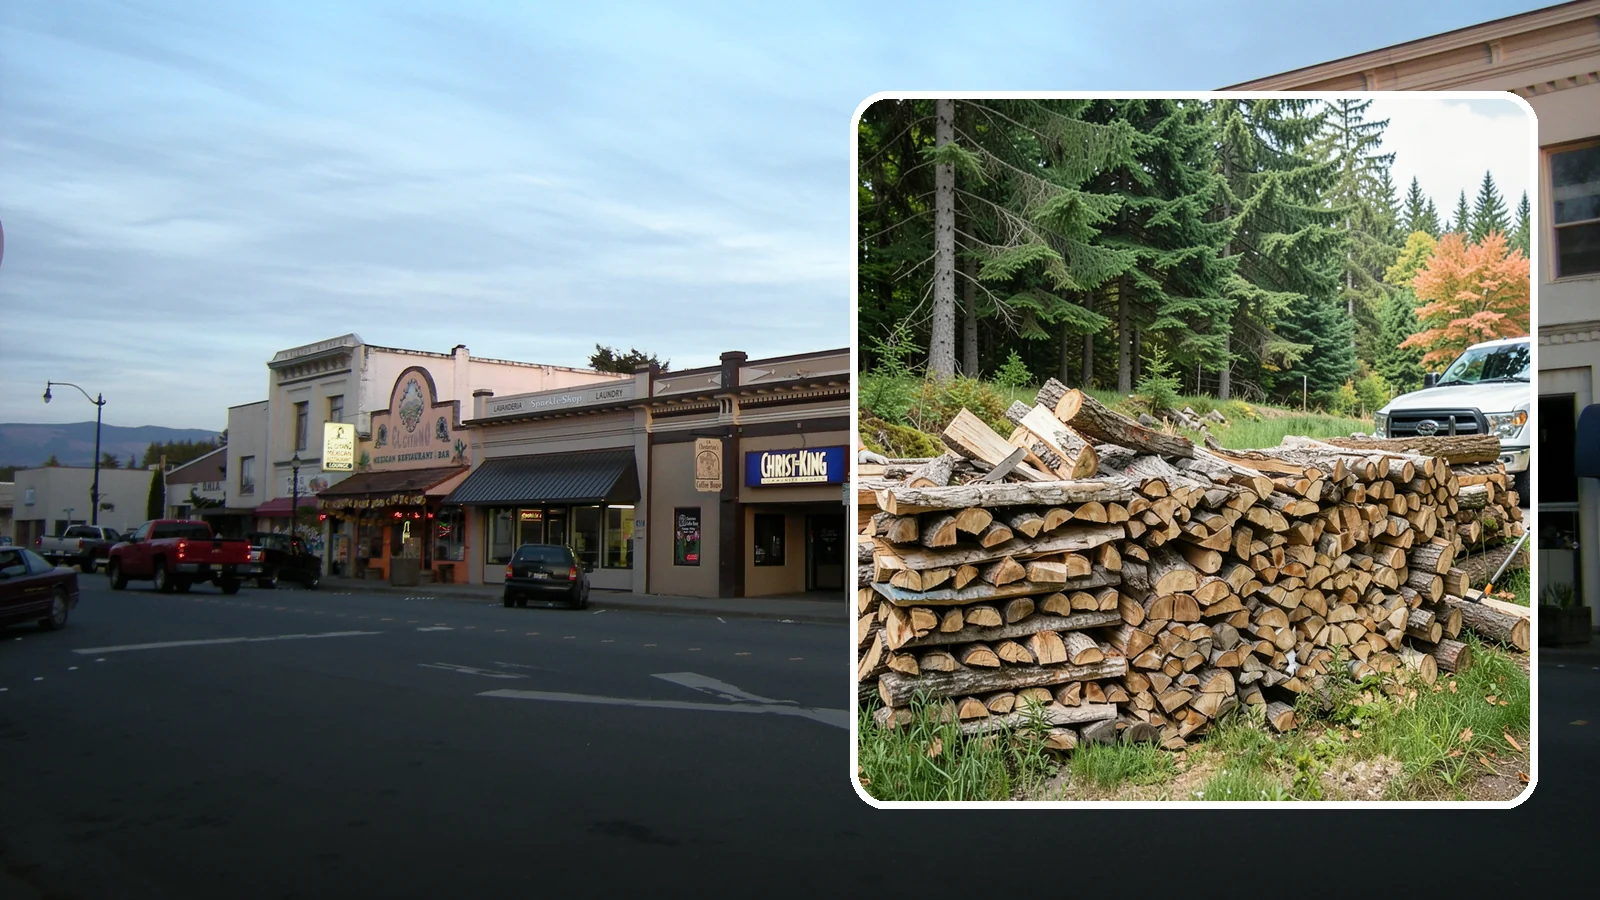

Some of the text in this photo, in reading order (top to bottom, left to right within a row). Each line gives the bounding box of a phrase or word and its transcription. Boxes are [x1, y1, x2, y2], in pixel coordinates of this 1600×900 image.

[493, 389, 623, 413] LAVANDERIA Sparkle Shop LAUNDRY
[373, 455, 396, 464] MEXICAN
[397, 452, 433, 462] RESTAURANT
[438, 450, 450, 459] BAR
[760, 450, 827, 478] CHRIST KING
